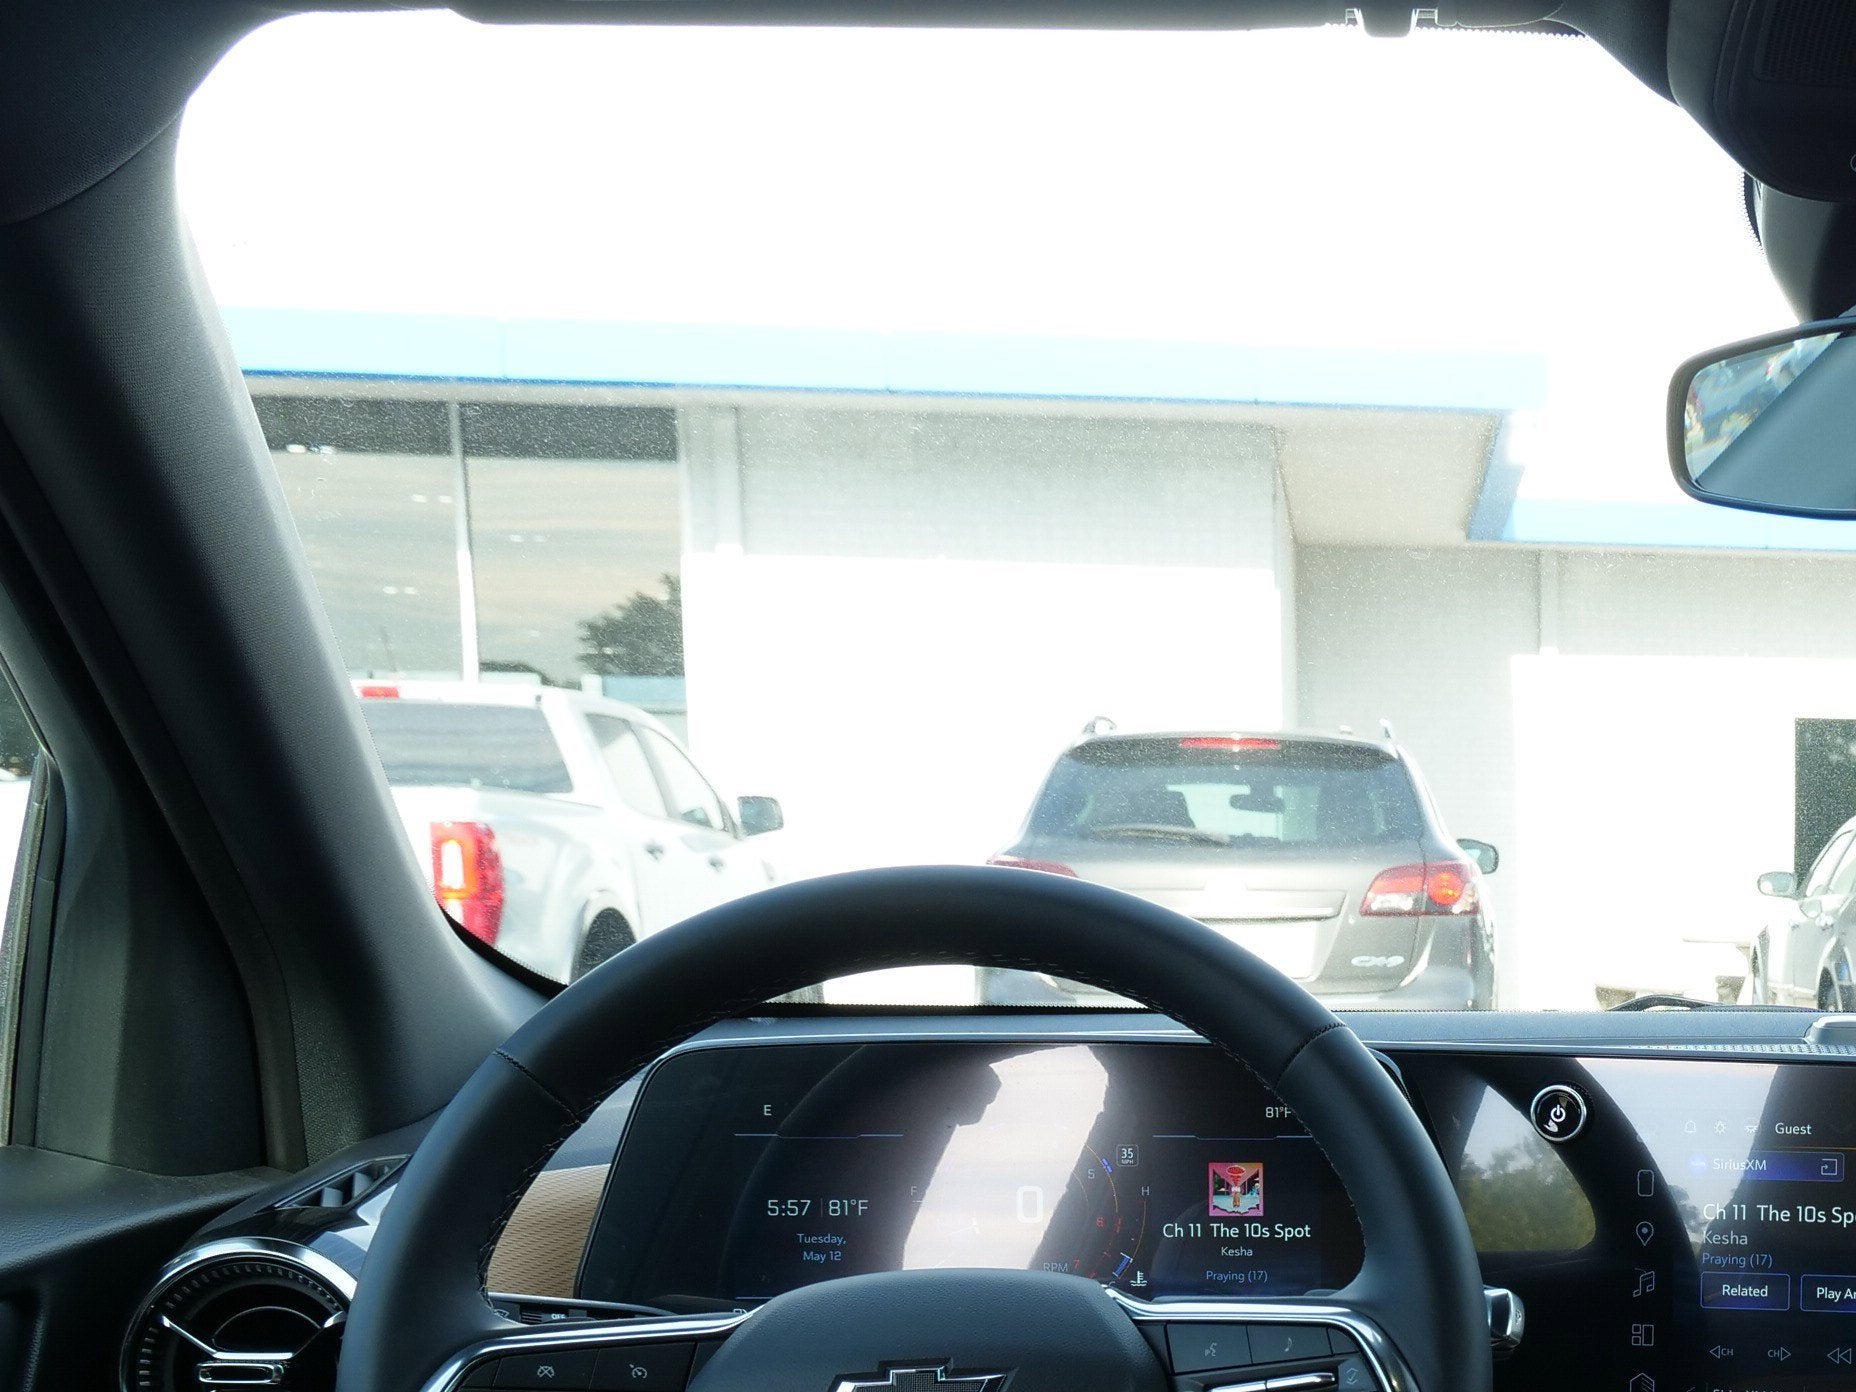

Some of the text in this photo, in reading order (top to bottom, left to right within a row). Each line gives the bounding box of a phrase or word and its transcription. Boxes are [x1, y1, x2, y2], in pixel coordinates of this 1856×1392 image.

[764, 1105, 771, 1115] E
[1775, 1123, 1812, 1134] Guest
[1121, 1148, 1133, 1158] 35
[1713, 1159, 1767, 1171] SiriusXM
[910, 1186, 917, 1196] F
[1141, 1186, 1149, 1195] H
[767, 1199, 868, 1216] 5:57 81°F
[1703, 1204, 1726, 1220] Ch
[1733, 1205, 1746, 1220] 11
[1757, 1205, 1790, 1222] The
[1797, 1206, 1826, 1223] 10s
[1163, 1223, 1311, 1241] Ch 11 The 10s Spot
[797, 1233, 847, 1246] Tuesday,
[1703, 1231, 1748, 1245] Kesha
[803, 1251, 842, 1263] May 12
[1221, 1247, 1253, 1256] Kesha
[1702, 1253, 1772, 1268] Praying (17)
[1043, 1263, 1068, 1272] RPM
[1206, 1271, 1268, 1282] Praying (17)
[1722, 1285, 1768, 1297] Related
[1816, 1287, 1841, 1302] Play
[1721, 1348, 1733, 1356] CH
[1768, 1349, 1780, 1358] CH
